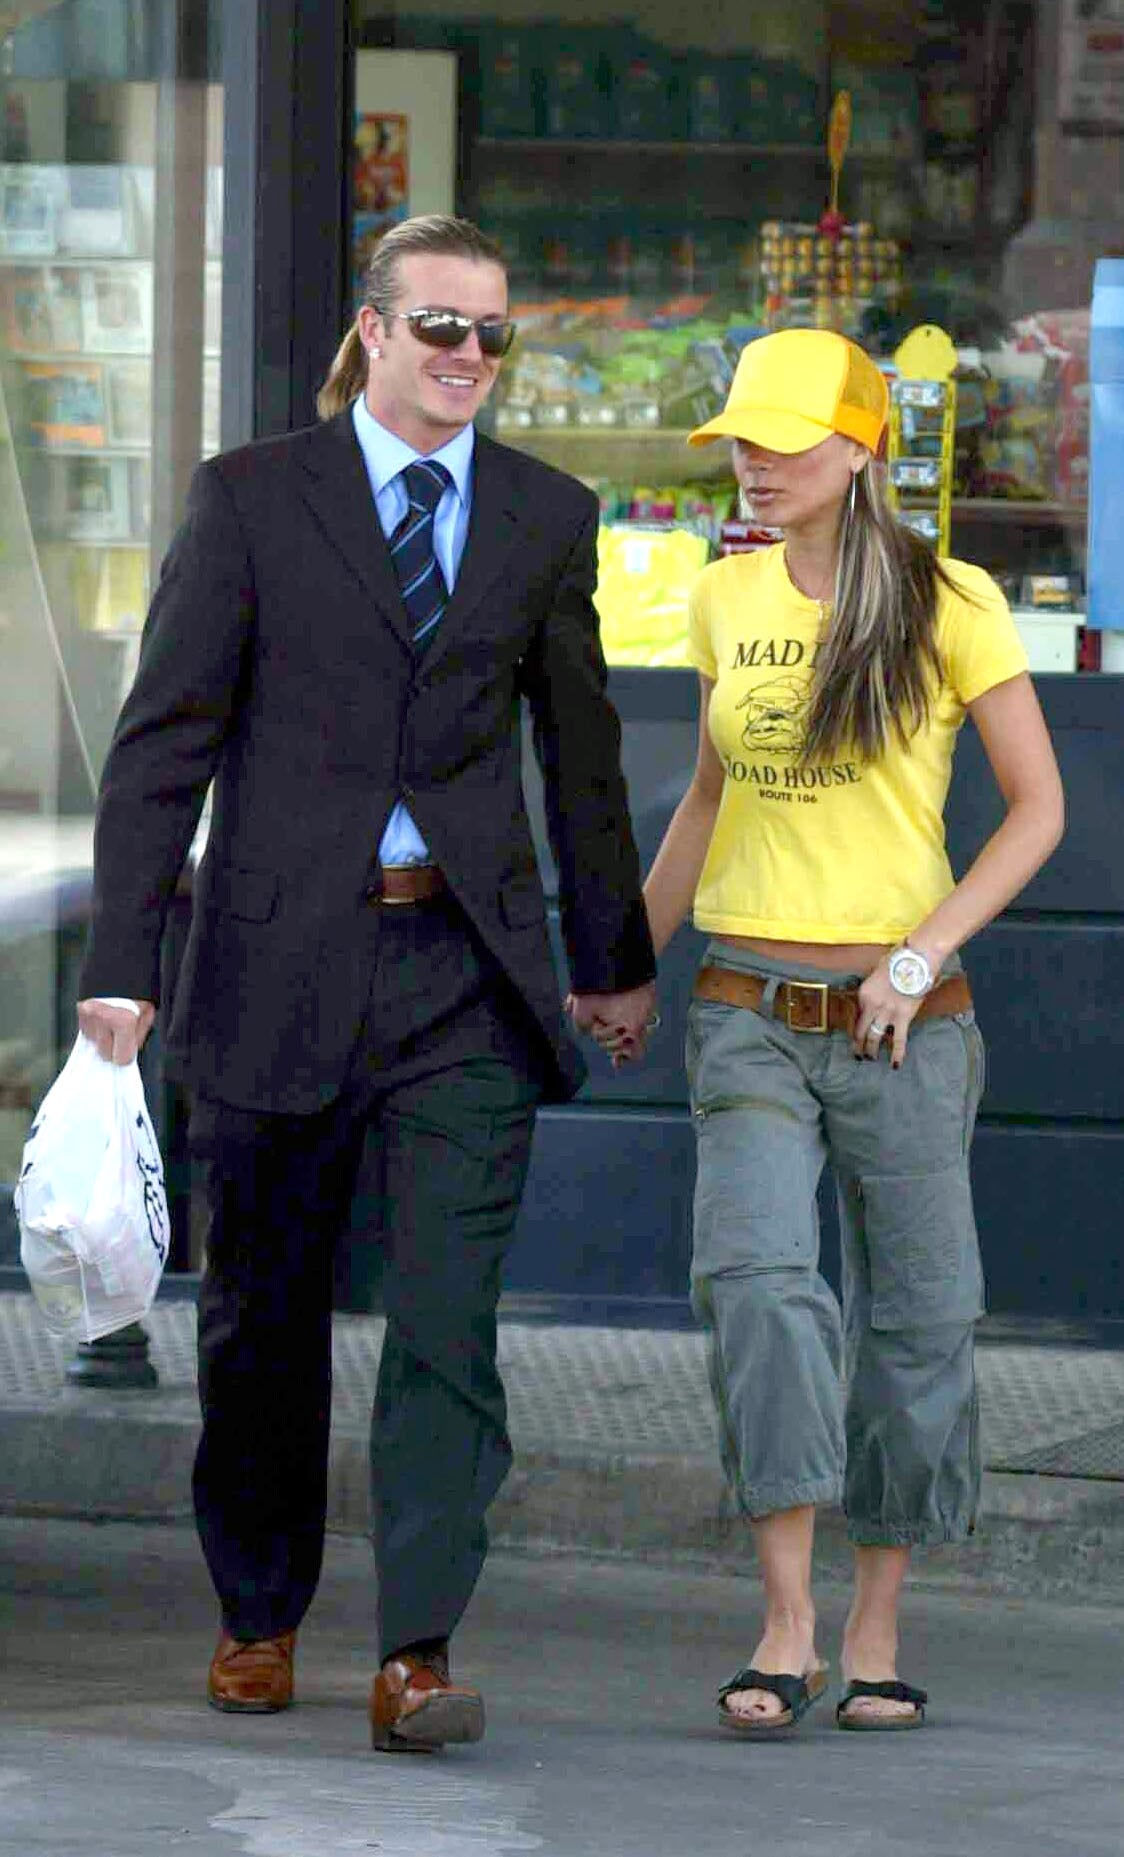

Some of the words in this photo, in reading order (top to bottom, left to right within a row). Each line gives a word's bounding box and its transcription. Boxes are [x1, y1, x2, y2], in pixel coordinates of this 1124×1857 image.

[731, 638, 804, 670] MAD
[784, 762, 862, 789] HOUSE
[759, 788, 793, 802] ROUTE
[797, 792, 819, 804] 106
